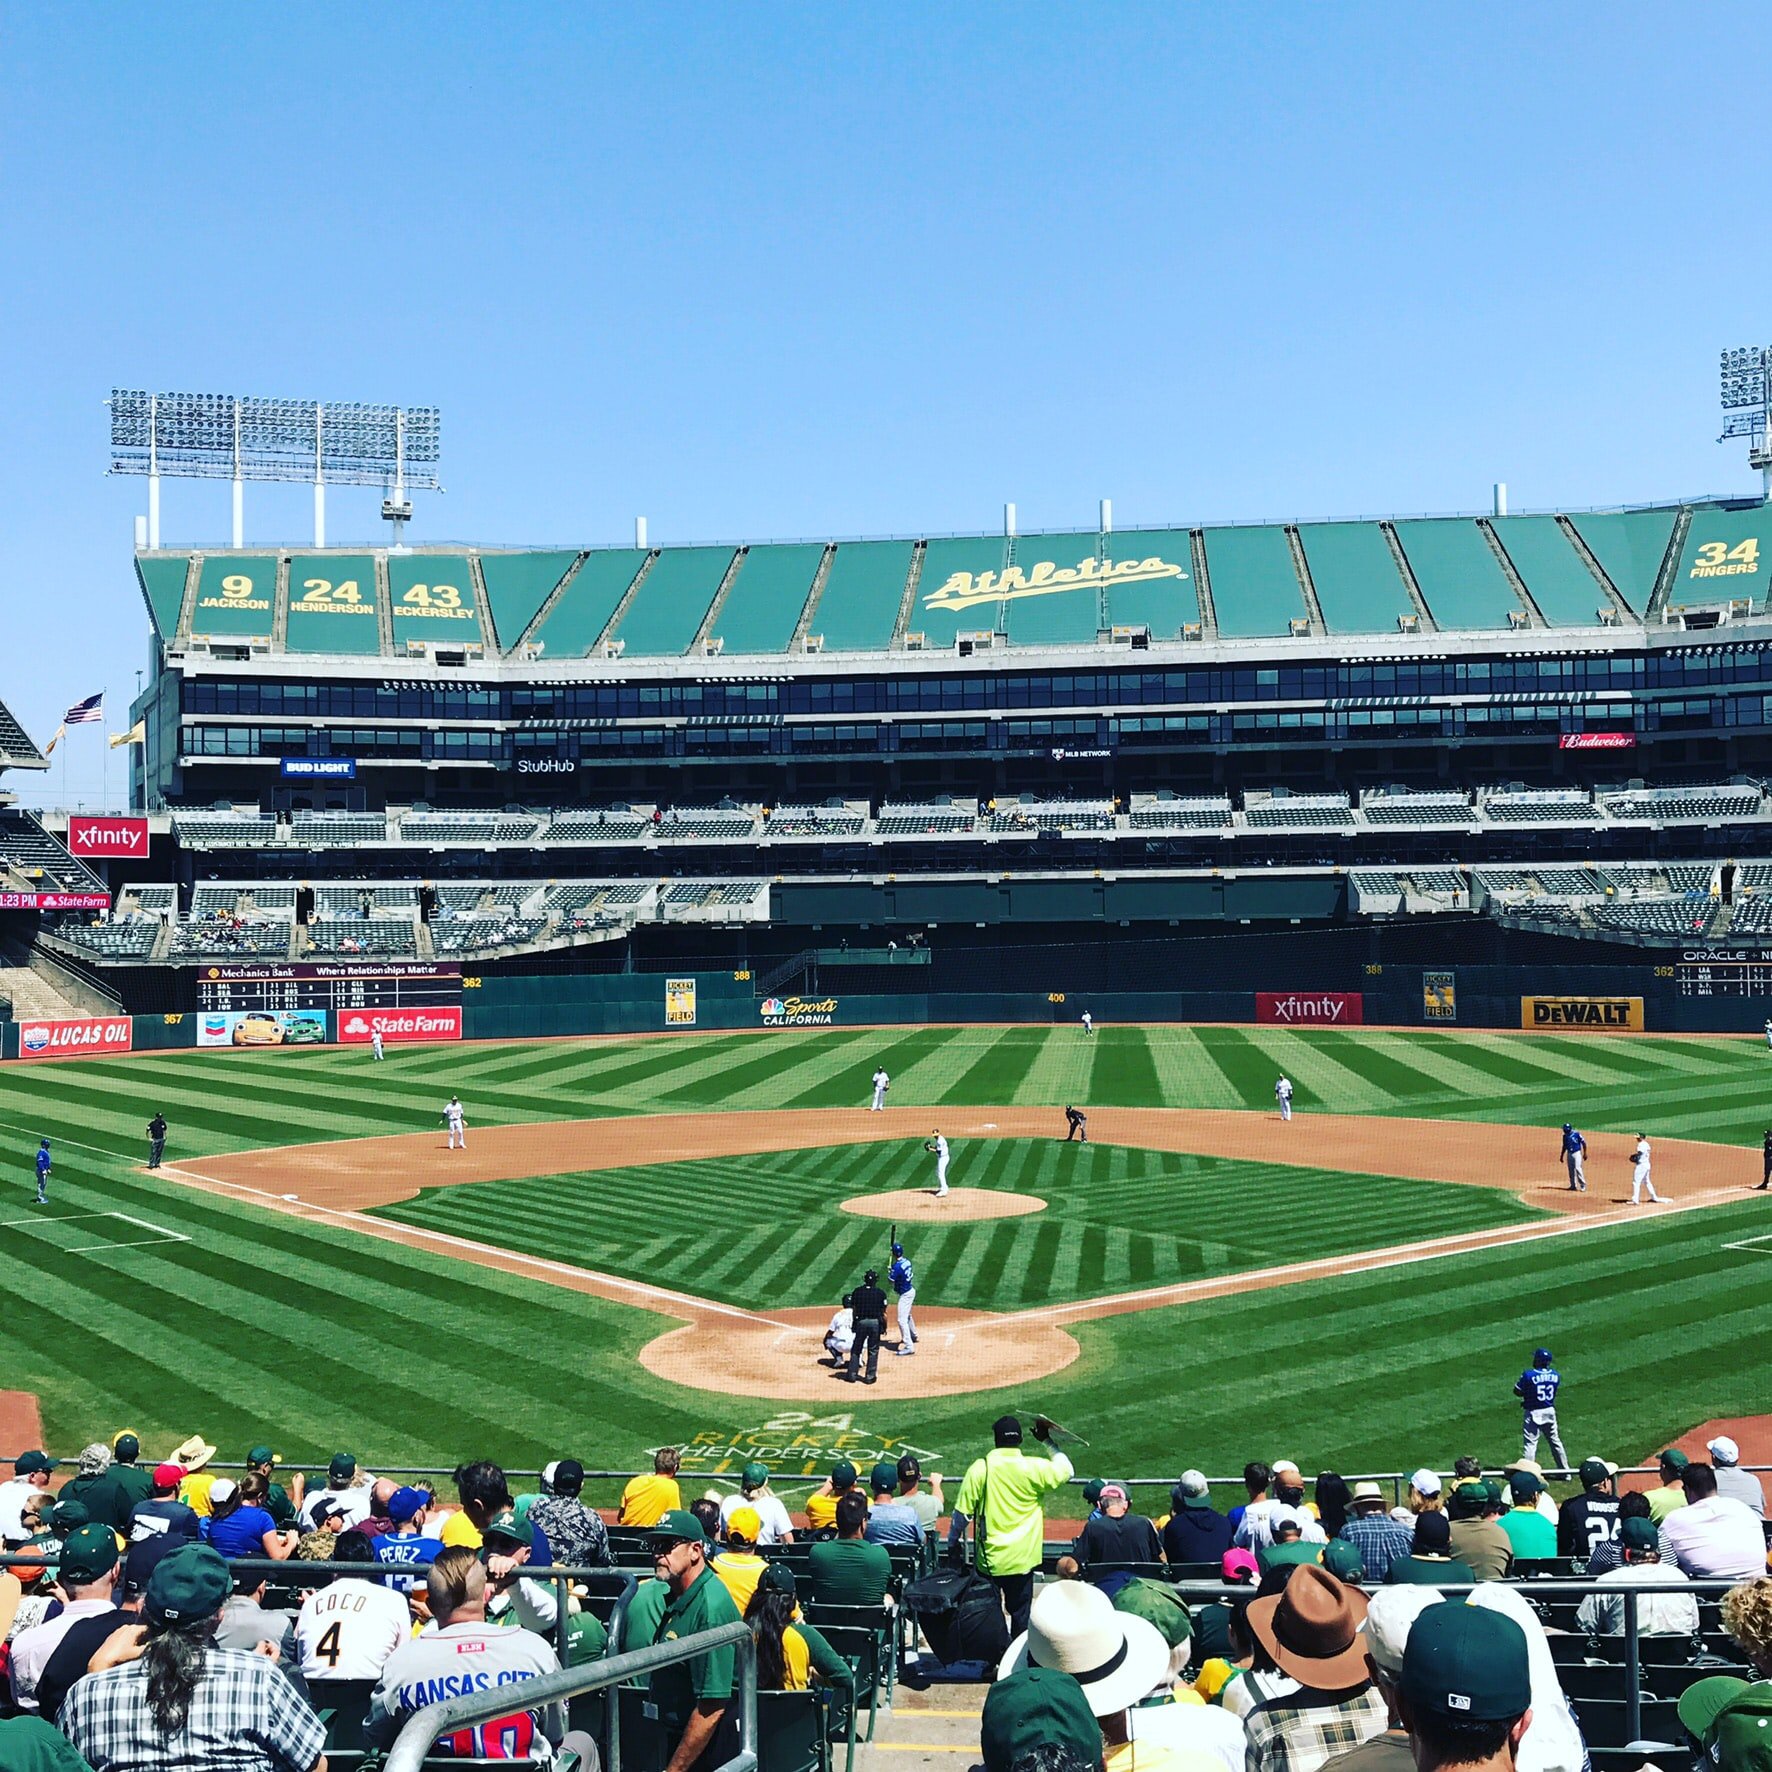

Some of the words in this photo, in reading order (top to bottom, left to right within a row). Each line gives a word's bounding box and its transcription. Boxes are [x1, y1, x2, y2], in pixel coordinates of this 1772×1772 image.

[1695, 538, 1760, 566] 34
[1690, 562, 1758, 579] FINGERS
[222, 575, 253, 598] 9
[922, 557, 1178, 604] Athletics
[302, 579, 362, 603] 24
[403, 584, 462, 608] 43
[199, 597, 269, 610] JACKSON
[291, 602, 374, 615] HENDERSON
[393, 606, 474, 619] ECKERSLEY
[1562, 734, 1632, 748] Budweiser
[286, 762, 312, 773] BUD
[313, 762, 350, 773] LIGHT
[518, 759, 575, 773] StubHub
[77, 826, 142, 848] xfinity
[22, 895, 37, 907] PM
[1683, 951, 1746, 960] ORACLE
[221, 968, 270, 978] Mechanics
[272, 968, 295, 977] Bank
[316, 967, 345, 975] Where
[347, 966, 406, 976] Relationships
[408, 965, 437, 974] Matter
[734, 971, 750, 981] 388
[1366, 965, 1383, 975] 388
[1653, 966, 1674, 977] 362
[463, 977, 482, 988] 362
[1048, 993, 1065, 1003] 400
[784, 996, 838, 1016] Sports
[1275, 996, 1344, 1021] xfinity
[1426, 1007, 1452, 1016] FIELD
[163, 1013, 184, 1025] 367
[668, 1011, 693, 1021] FIELD
[763, 1014, 832, 1026] CALIFORNIA
[50, 1025, 102, 1046] LUCAS
[105, 1024, 128, 1043] OIL
[1537, 1384, 1554, 1401] 53
[764, 1412, 854, 1431] 24
[692, 1430, 909, 1449] RICKEY
[680, 1445, 908, 1460] HENDERSON
[379, 1545, 421, 1564] PEREZ
[315, 1593, 367, 1615] COCO
[315, 1621, 342, 1668] 4
[400, 1672, 489, 1712] KANSAS
